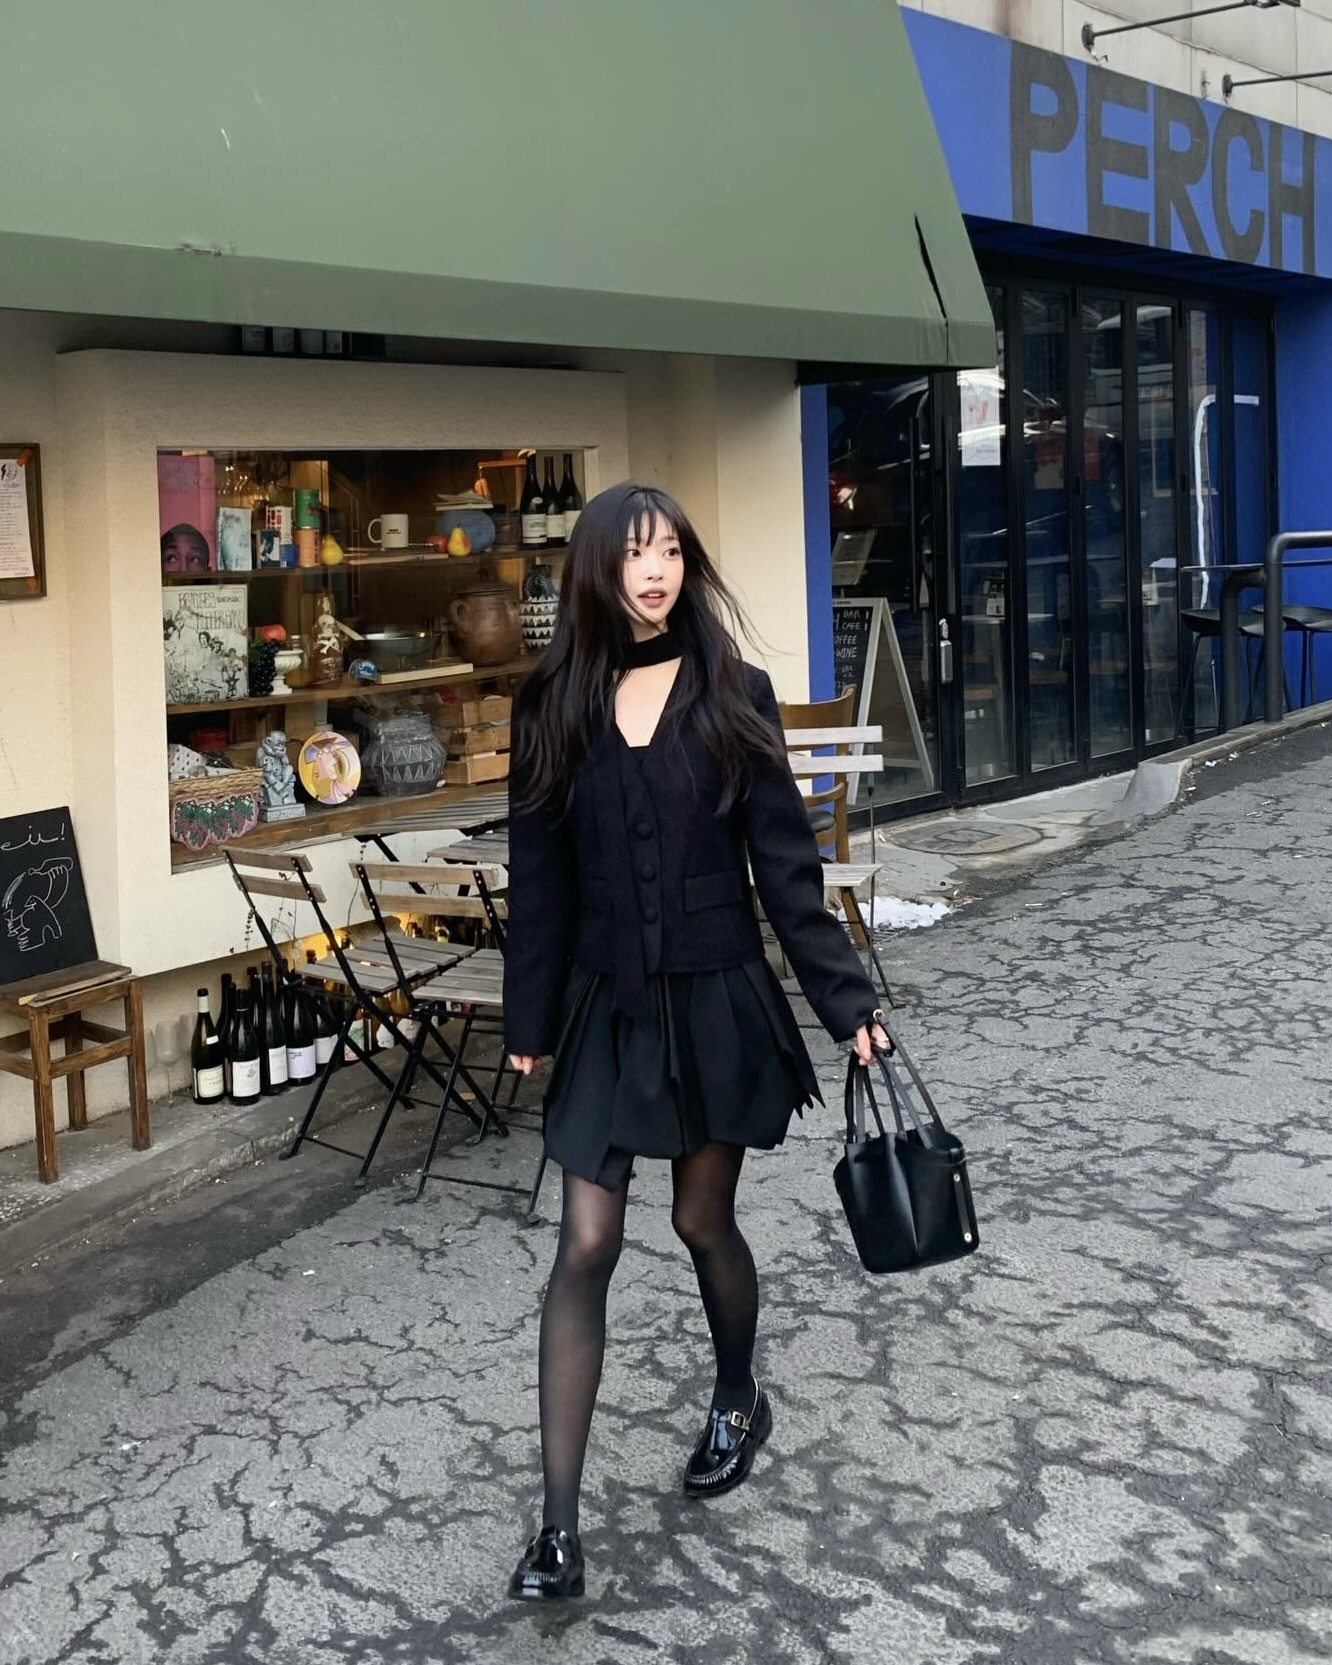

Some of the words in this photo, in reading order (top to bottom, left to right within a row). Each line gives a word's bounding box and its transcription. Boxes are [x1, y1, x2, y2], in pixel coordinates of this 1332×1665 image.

[1010, 40, 1316, 275] PERCH
[834, 635, 857, 645] OFFEE
[836, 647, 858, 658] WINE
